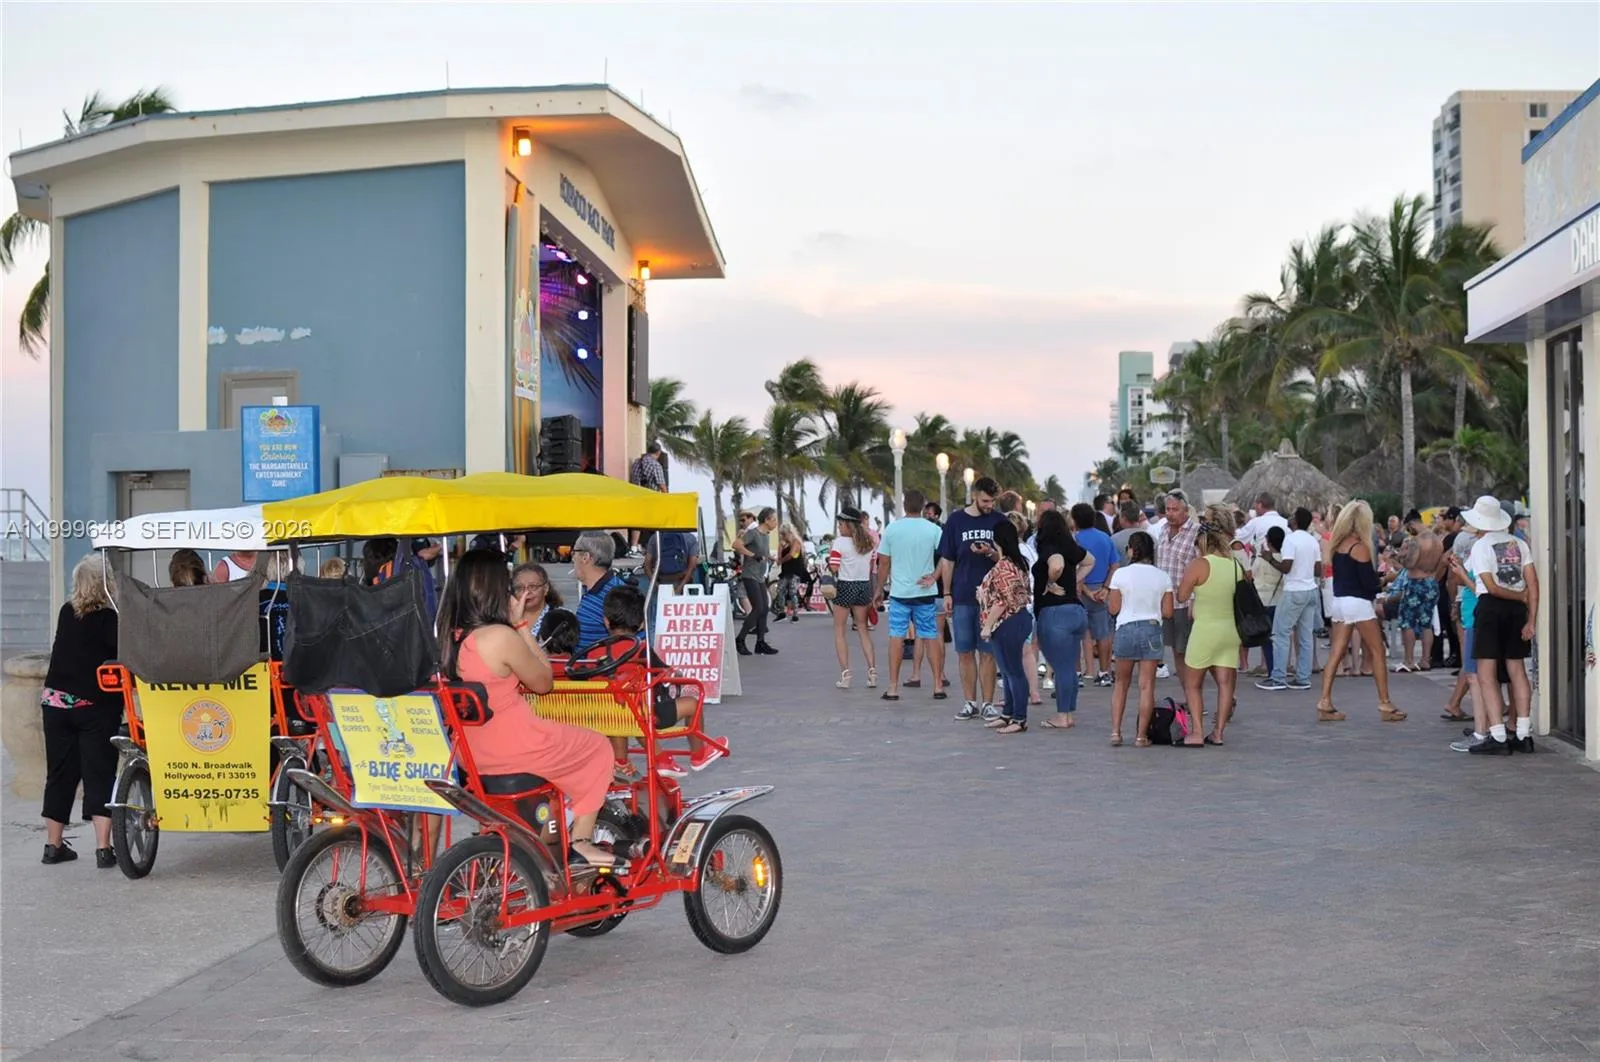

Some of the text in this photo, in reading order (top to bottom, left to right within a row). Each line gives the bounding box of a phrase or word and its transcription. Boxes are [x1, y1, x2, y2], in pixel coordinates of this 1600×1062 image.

[663, 603, 720, 617] EVENT
[666, 619, 714, 632] AREA
[661, 635, 718, 650] PLEASE
[665, 651, 711, 666] WALK
[411, 727, 440, 735] RENTALS
[203, 761, 253, 769] Broadwalk
[368, 760, 401, 782] BIKE
[164, 772, 215, 780] Hollywood,
[163, 788, 260, 799] 954-925-0735
[548, 820, 557, 834] E
